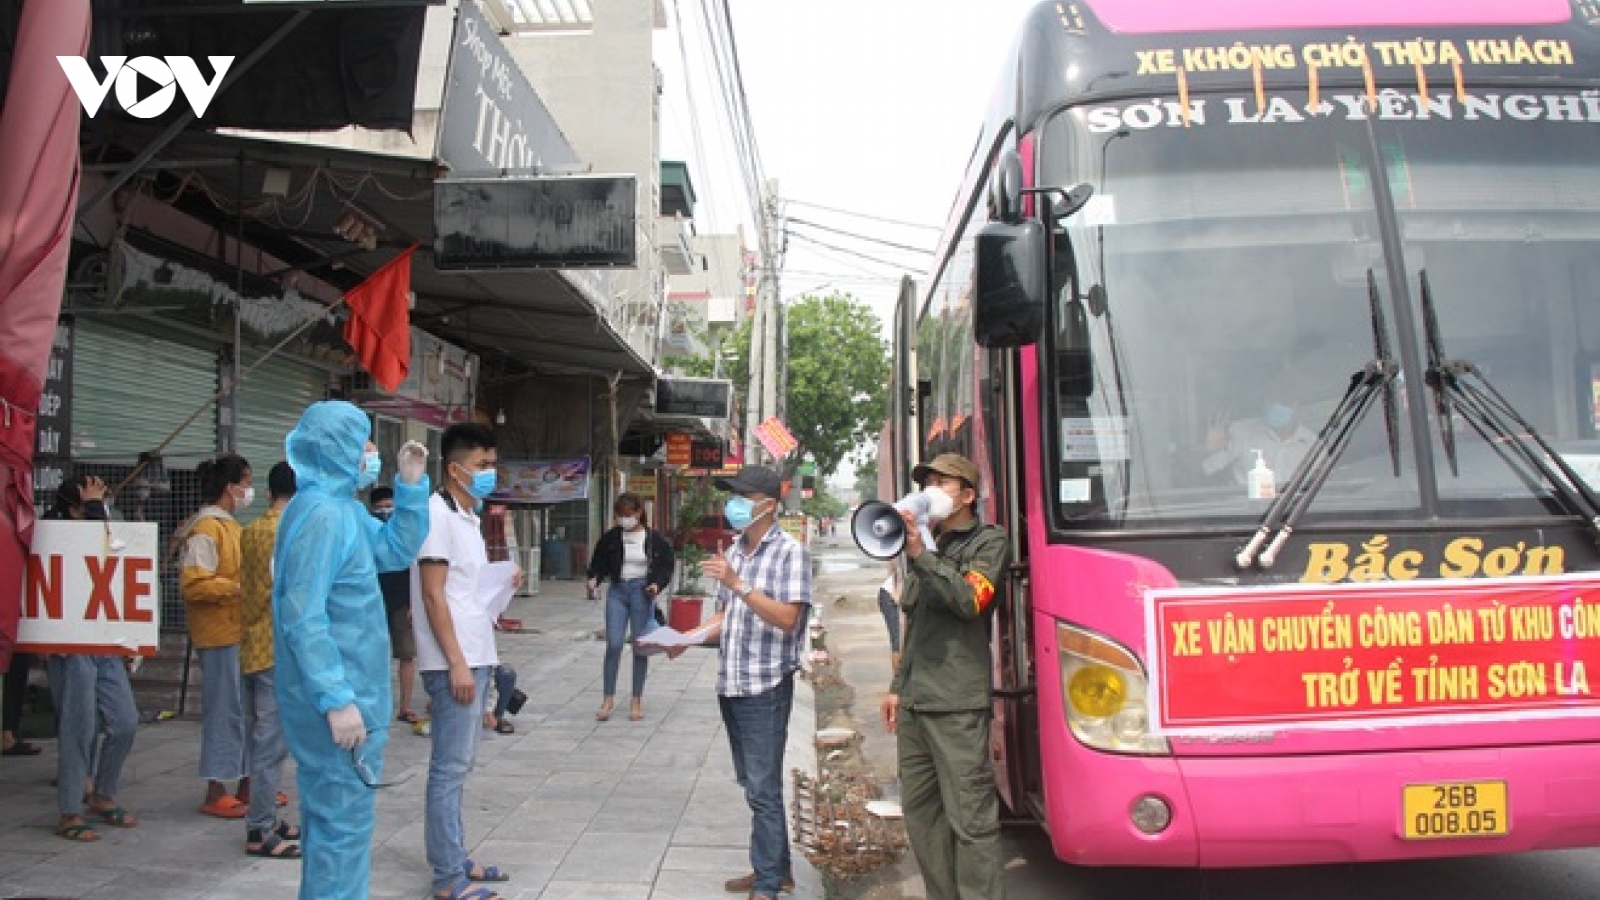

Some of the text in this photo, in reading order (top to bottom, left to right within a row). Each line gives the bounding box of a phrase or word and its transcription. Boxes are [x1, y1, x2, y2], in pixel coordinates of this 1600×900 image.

[1135, 49, 1176, 75] XE
[1182, 41, 1296, 72] KHÔNG
[1302, 35, 1366, 67] CHỞ
[1466, 35, 1575, 65] KHÁCH
[1087, 97, 1206, 133] SƠN
[1224, 96, 1305, 123] LA
[1332, 88, 1452, 120] YÊN
[1299, 534, 1565, 584] Bắc Sơn
[19, 554, 153, 622] N XE
[1171, 620, 1203, 656] XE
[1206, 612, 1256, 663] VẬN
[1261, 600, 1354, 652] CHUYỂN
[1358, 604, 1423, 648] CÔNG
[1427, 602, 1475, 645] DÂN
[1478, 599, 1507, 643] TỪ
[1510, 606, 1553, 642] KHU
[1301, 654, 1591, 708] TRỞ VỀ TỈNH SƠN LA
[1433, 785, 1477, 809] 26B
[1415, 809, 1497, 836] 008.05
